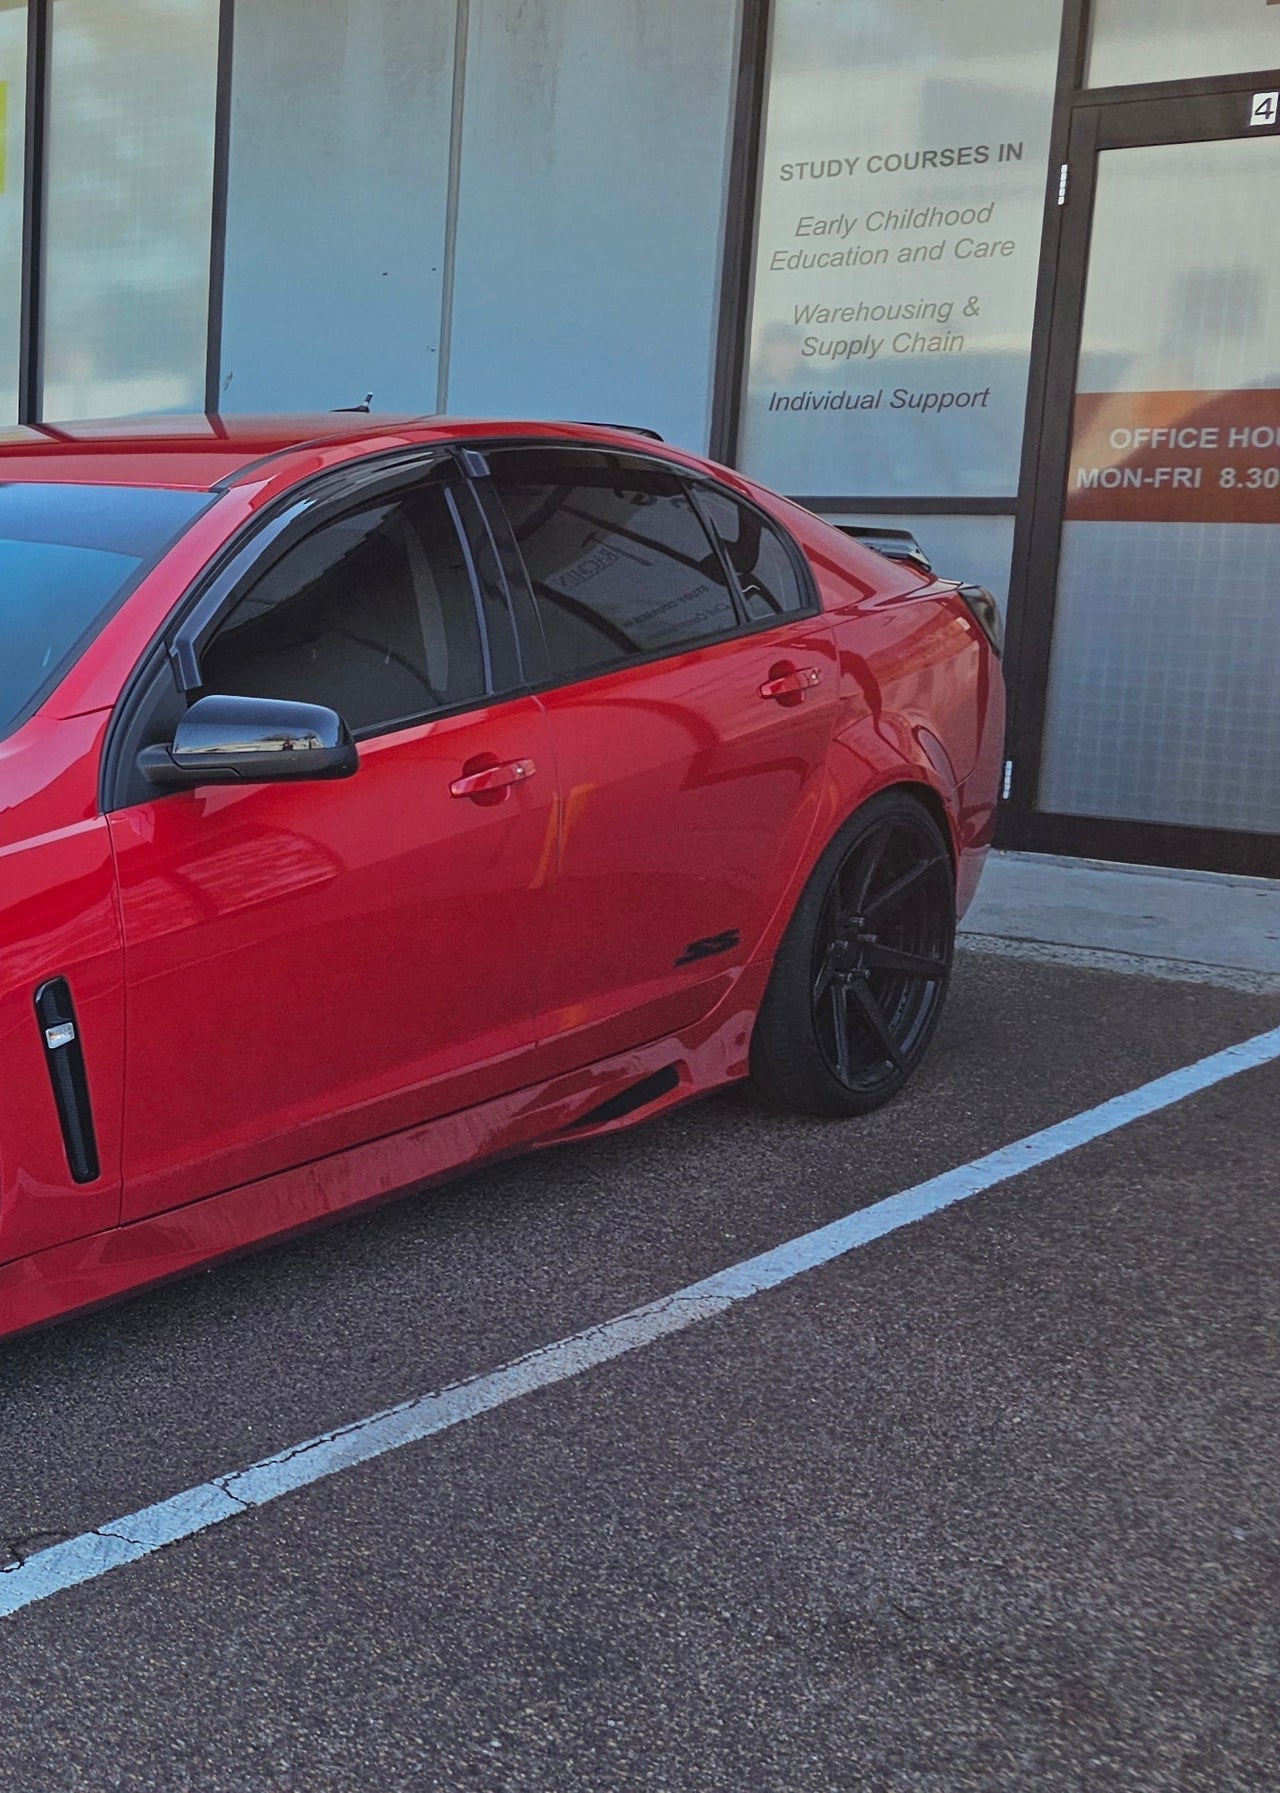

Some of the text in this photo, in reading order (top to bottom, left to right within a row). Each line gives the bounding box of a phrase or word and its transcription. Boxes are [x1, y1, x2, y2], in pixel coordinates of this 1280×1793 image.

[1254, 97, 1274, 119] 4
[779, 142, 1024, 182] STUDY COURSES IN
[795, 202, 995, 240] Early Childhood
[769, 237, 1016, 271] Education and Care
[793, 295, 981, 325] Warehousing &
[800, 330, 965, 361] Supply Chain
[768, 387, 992, 413] Individual Support
[1109, 426, 1280, 449] OFFICE HO
[1076, 467, 1280, 489] MON-FRI 8.30
